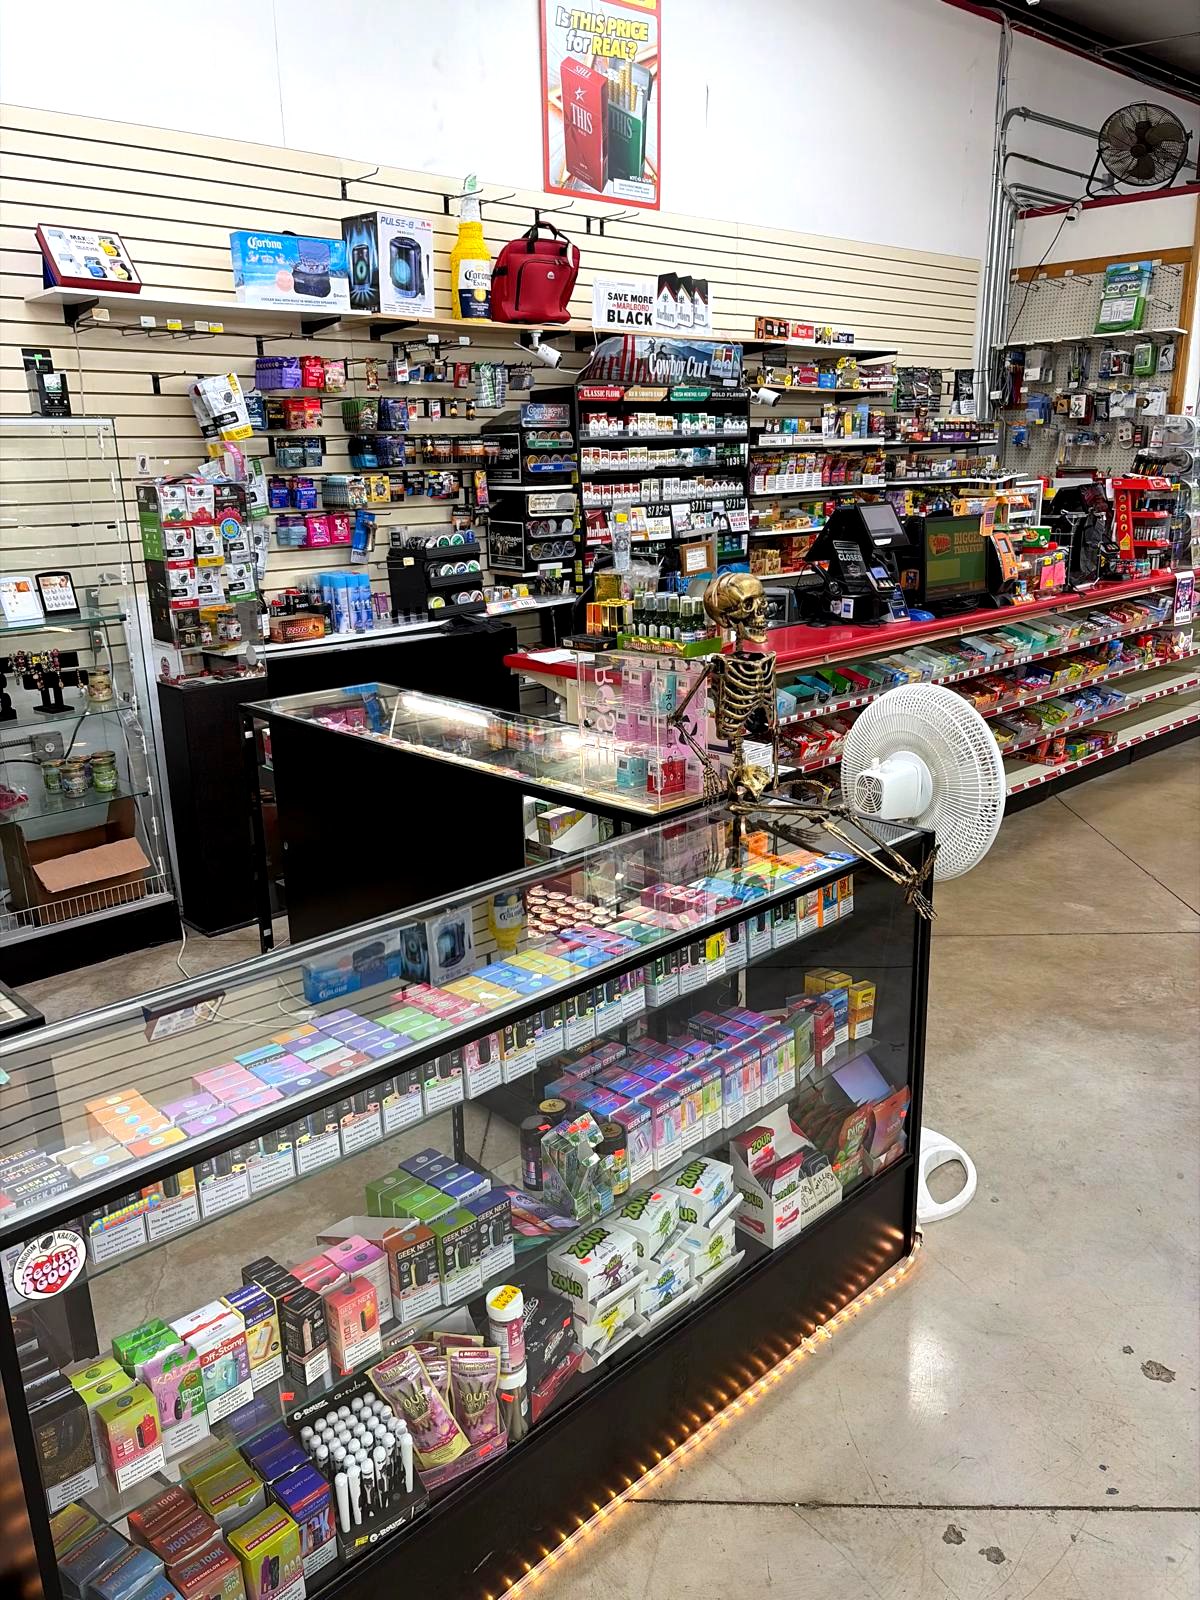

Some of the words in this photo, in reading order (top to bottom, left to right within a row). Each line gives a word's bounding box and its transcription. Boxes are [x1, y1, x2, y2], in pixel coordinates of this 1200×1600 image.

[555, 6, 571, 28] Is
[570, 10, 606, 35] THIS
[605, 14, 649, 42] PRICE
[566, 29, 592, 53] for
[591, 34, 638, 62] REAL?
[570, 102, 593, 135] THIS
[610, 110, 633, 139] THIS
[247, 236, 283, 250] Corona
[608, 292, 628, 301] SAVE
[630, 294, 654, 304] MORE
[616, 303, 650, 312] MARLBORO
[607, 310, 653, 326] BLACK
[649, 353, 686, 379] Cowboy
[687, 356, 709, 378] Cut
[657, 1102, 670, 1114] GEEK
[627, 1116, 641, 1129] GEEK
[752, 1133, 772, 1154] ZOUR
[16, 1178, 42, 1192] GEEK
[43, 1170, 61, 1180] PRO
[676, 1160, 708, 1189] ZOUR
[24, 1191, 49, 1206] GEEK
[621, 1189, 653, 1220] ZOUR
[782, 1200, 795, 1212] 10CT
[478, 1210, 494, 1222] GEEK
[494, 1201, 510, 1213] NEXT
[443, 1232, 460, 1244] GEEK
[461, 1223, 477, 1234] NEXT
[568, 1228, 611, 1259] ZOUR
[17, 1244, 37, 1270] KINGDOM
[57, 1233, 78, 1242] KRATOM
[398, 1247, 416, 1259] GEEK
[416, 1238, 435, 1250] NEXT
[22, 1249, 76, 1294] feelin
[37, 1256, 79, 1291] GOOD
[551, 1270, 583, 1299] ZOUR
[357, 1293, 374, 1306] NEXT
[202, 1337, 245, 1364] Off-Stamp
[157, 1490, 181, 1509] 100K
[247, 1540, 259, 1550] SOUR
[259, 1520, 288, 1540] STRAWBERRY
[201, 1548, 225, 1564] 100K
[187, 1564, 220, 1588] WATERMELON
